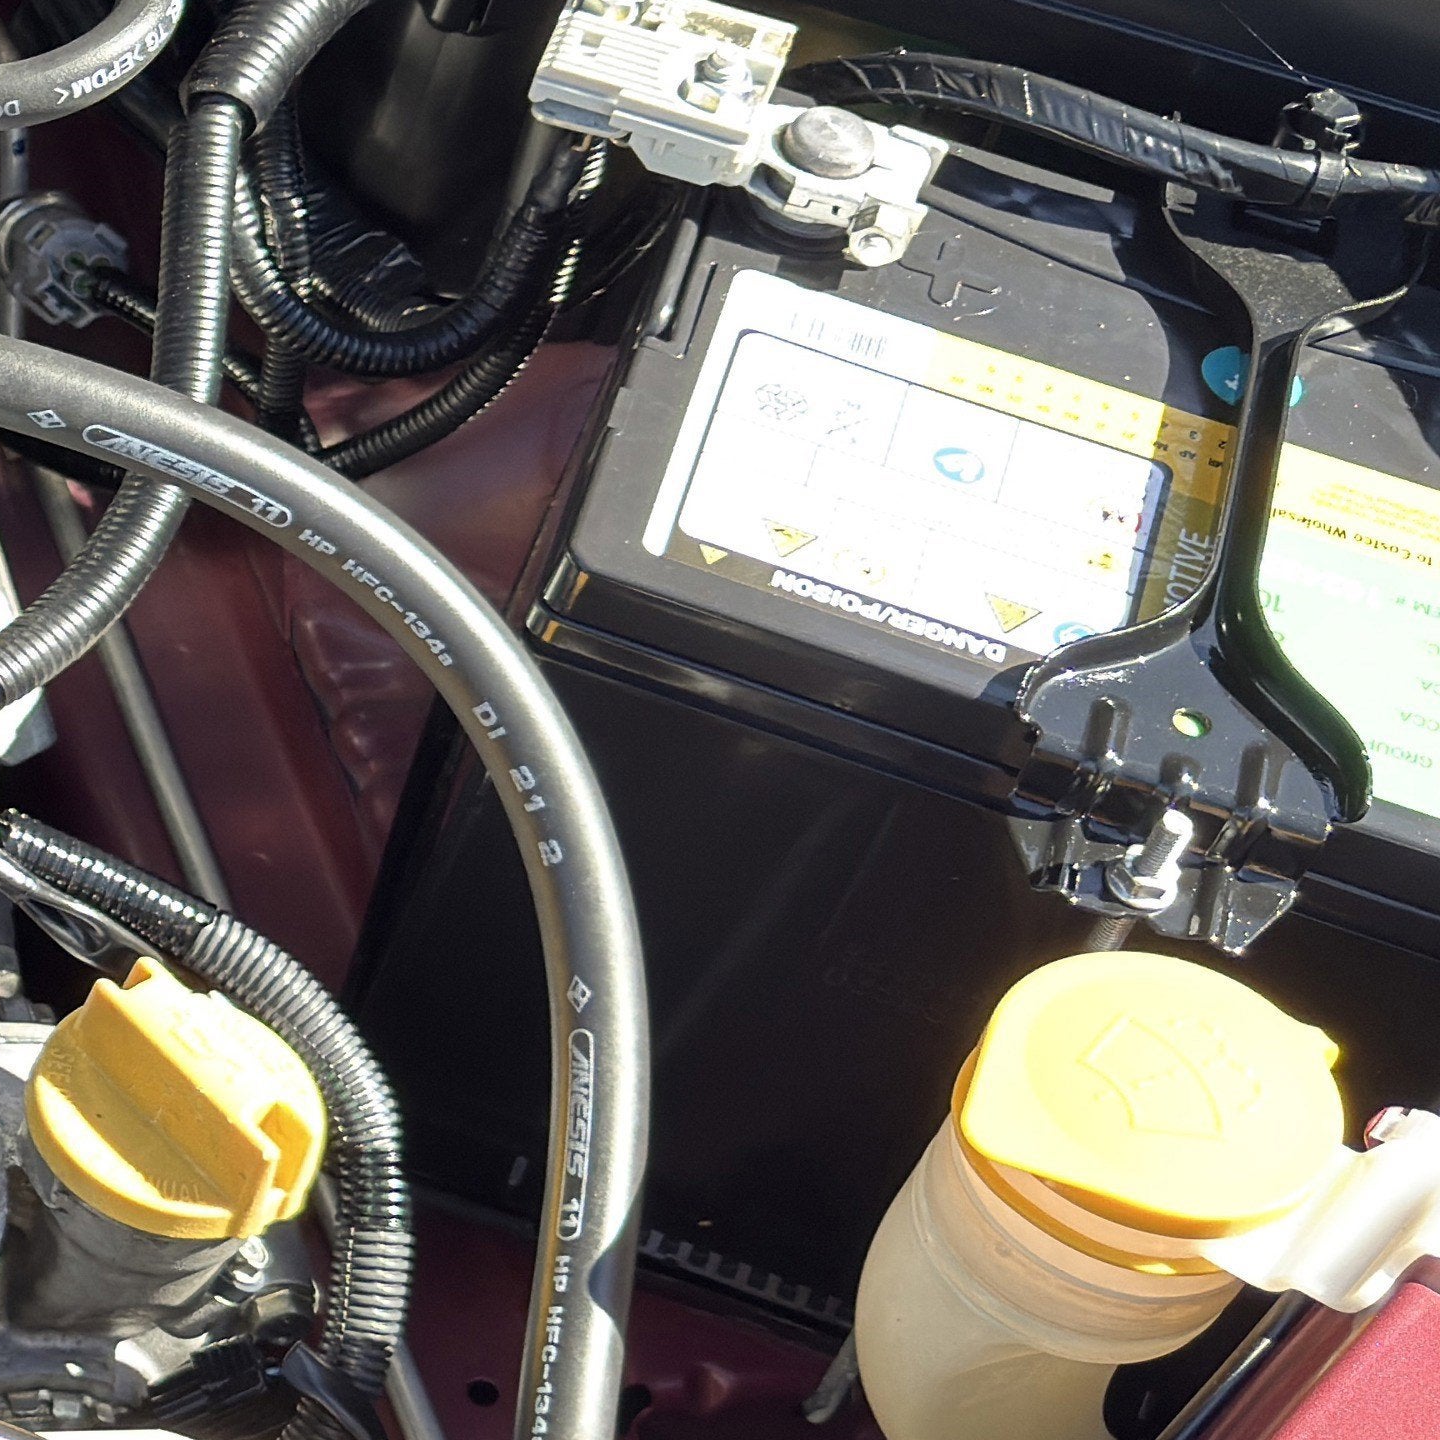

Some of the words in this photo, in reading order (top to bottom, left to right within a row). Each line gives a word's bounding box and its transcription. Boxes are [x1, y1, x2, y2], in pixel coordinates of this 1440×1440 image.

[1269, 507, 1347, 540] Wholesal
[1354, 530, 1411, 561] Costco
[296, 527, 339, 561] HP
[342, 556, 454, 668] HFC-134a
[770, 569, 1007, 664] DANGER/POISON
[550, 1254, 574, 1293] HP
